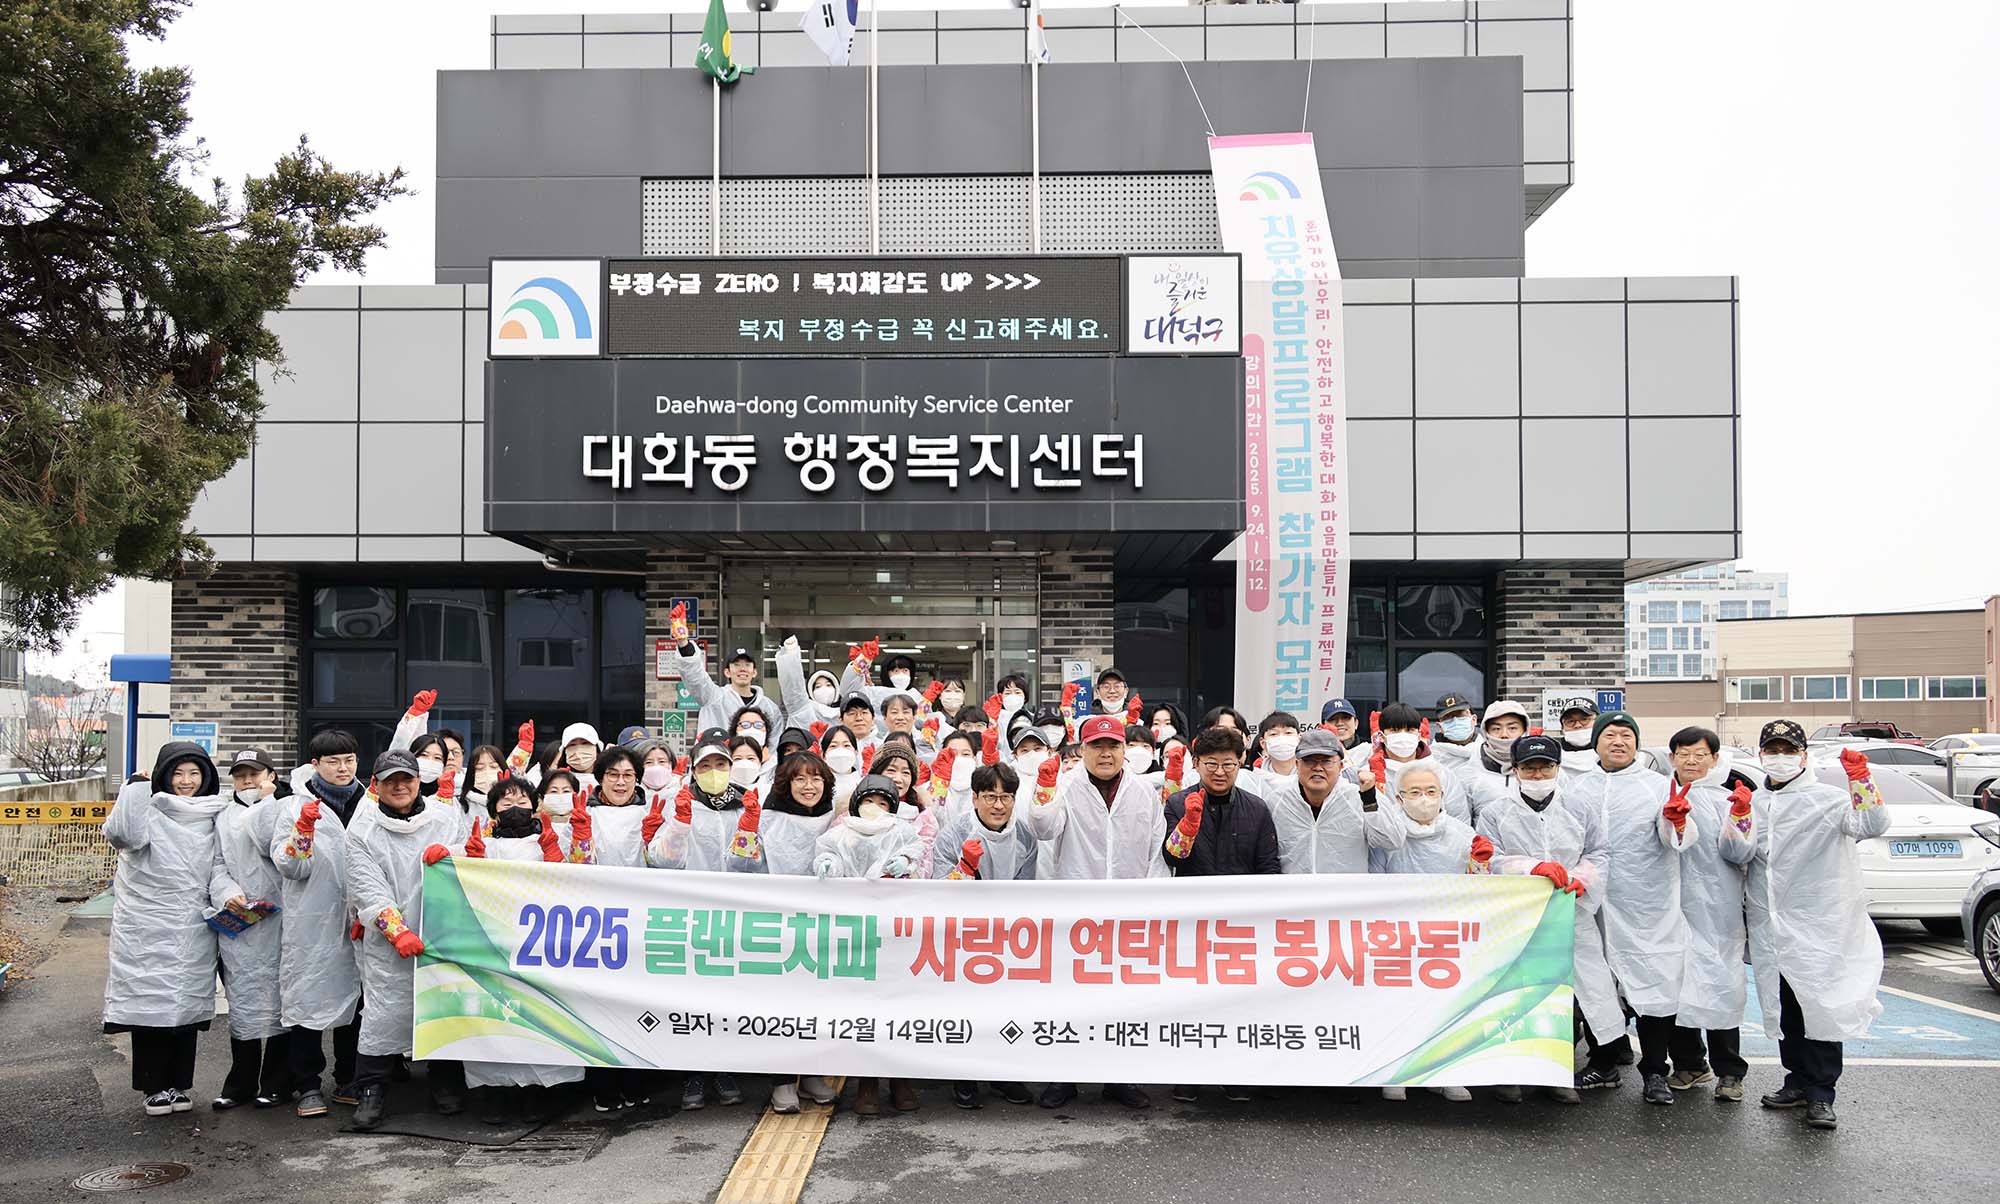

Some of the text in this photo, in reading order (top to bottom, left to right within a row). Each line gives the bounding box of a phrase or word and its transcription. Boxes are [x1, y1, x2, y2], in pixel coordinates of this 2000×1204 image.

[609, 272, 701, 296] 부정수급
[714, 273, 779, 293] ZERO
[940, 273, 973, 292] UP
[738, 317, 1109, 342] 복지 부정수급 꼭 신고해주세요.
[1144, 316, 1223, 345] 대덕구
[1315, 338, 1333, 407] 안전하고
[656, 395, 1073, 419] Daehwa-dong Community Service Center
[1318, 413, 1335, 468] 행복한
[583, 431, 1144, 492] 대화동 행정복지센터
[1261, 214, 1316, 711] 치유상담프로그램 참가자 모집
[1250, 505, 1263, 518] 9.
[1247, 522, 1268, 540] 24.
[1248, 559, 1268, 572] 12.
[1248, 577, 1268, 591] 12.
[1603, 694, 1615, 704] 10
[4, 807, 106, 818] 안전 제일
[1926, 842, 1954, 854] 1099
[516, 904, 1480, 989] 2025 플랜트치과 "사랑의 연탄나눔 봉사활동"
[669, 1012, 714, 1036] 일자
[737, 1015, 818, 1041] 2025년
[827, 1016, 876, 1043] 12월
[885, 1018, 973, 1044] 14일(일)
[1032, 1020, 1081, 1046] 장소
[1104, 1021, 1149, 1048] 대전
[1159, 1022, 1228, 1049] 대덕구
[1237, 1023, 1307, 1050] 대화동
[1314, 1024, 1361, 1051] 일대
